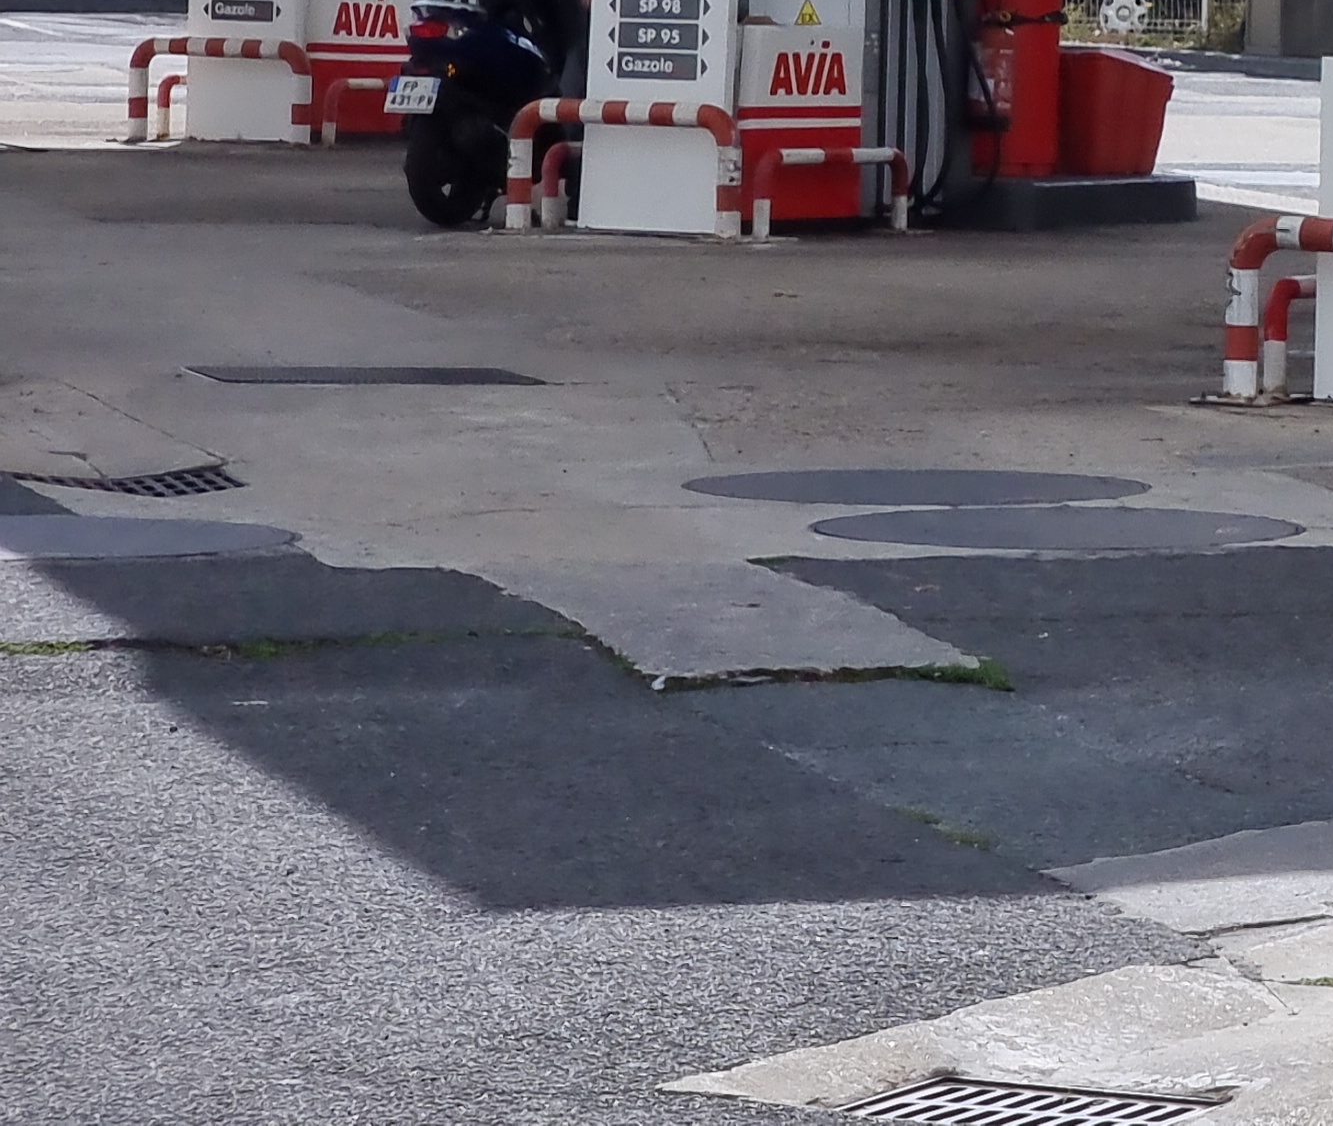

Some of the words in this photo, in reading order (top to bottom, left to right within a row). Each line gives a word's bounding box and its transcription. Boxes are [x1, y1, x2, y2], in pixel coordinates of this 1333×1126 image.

[214, 2, 256, 16] Gazole
[637, 28, 656, 43] SP
[660, 29, 680, 44] 95
[621, 56, 673, 73] Gazole
